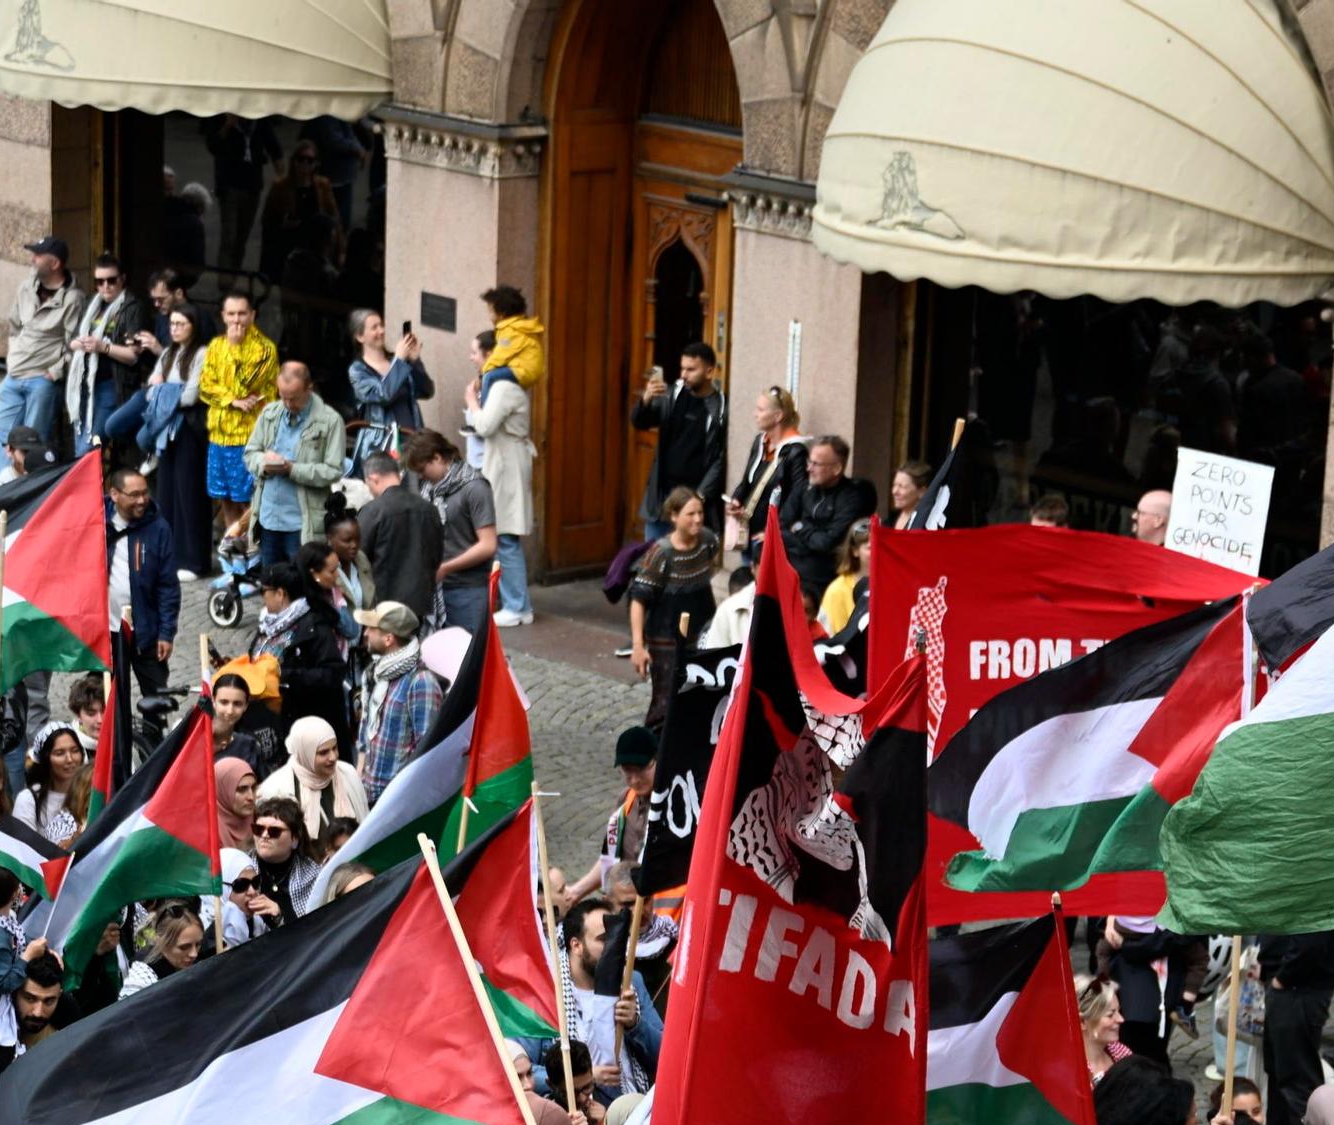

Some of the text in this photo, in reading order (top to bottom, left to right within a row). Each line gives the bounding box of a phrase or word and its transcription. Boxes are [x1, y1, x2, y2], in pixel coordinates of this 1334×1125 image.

[1191, 461, 1246, 487] ZERO
[1191, 484, 1253, 516] POINTS
[1197, 508, 1228, 531] FOR
[1172, 527, 1254, 559] GENOCIDE
[969, 638, 1072, 681] FROM
